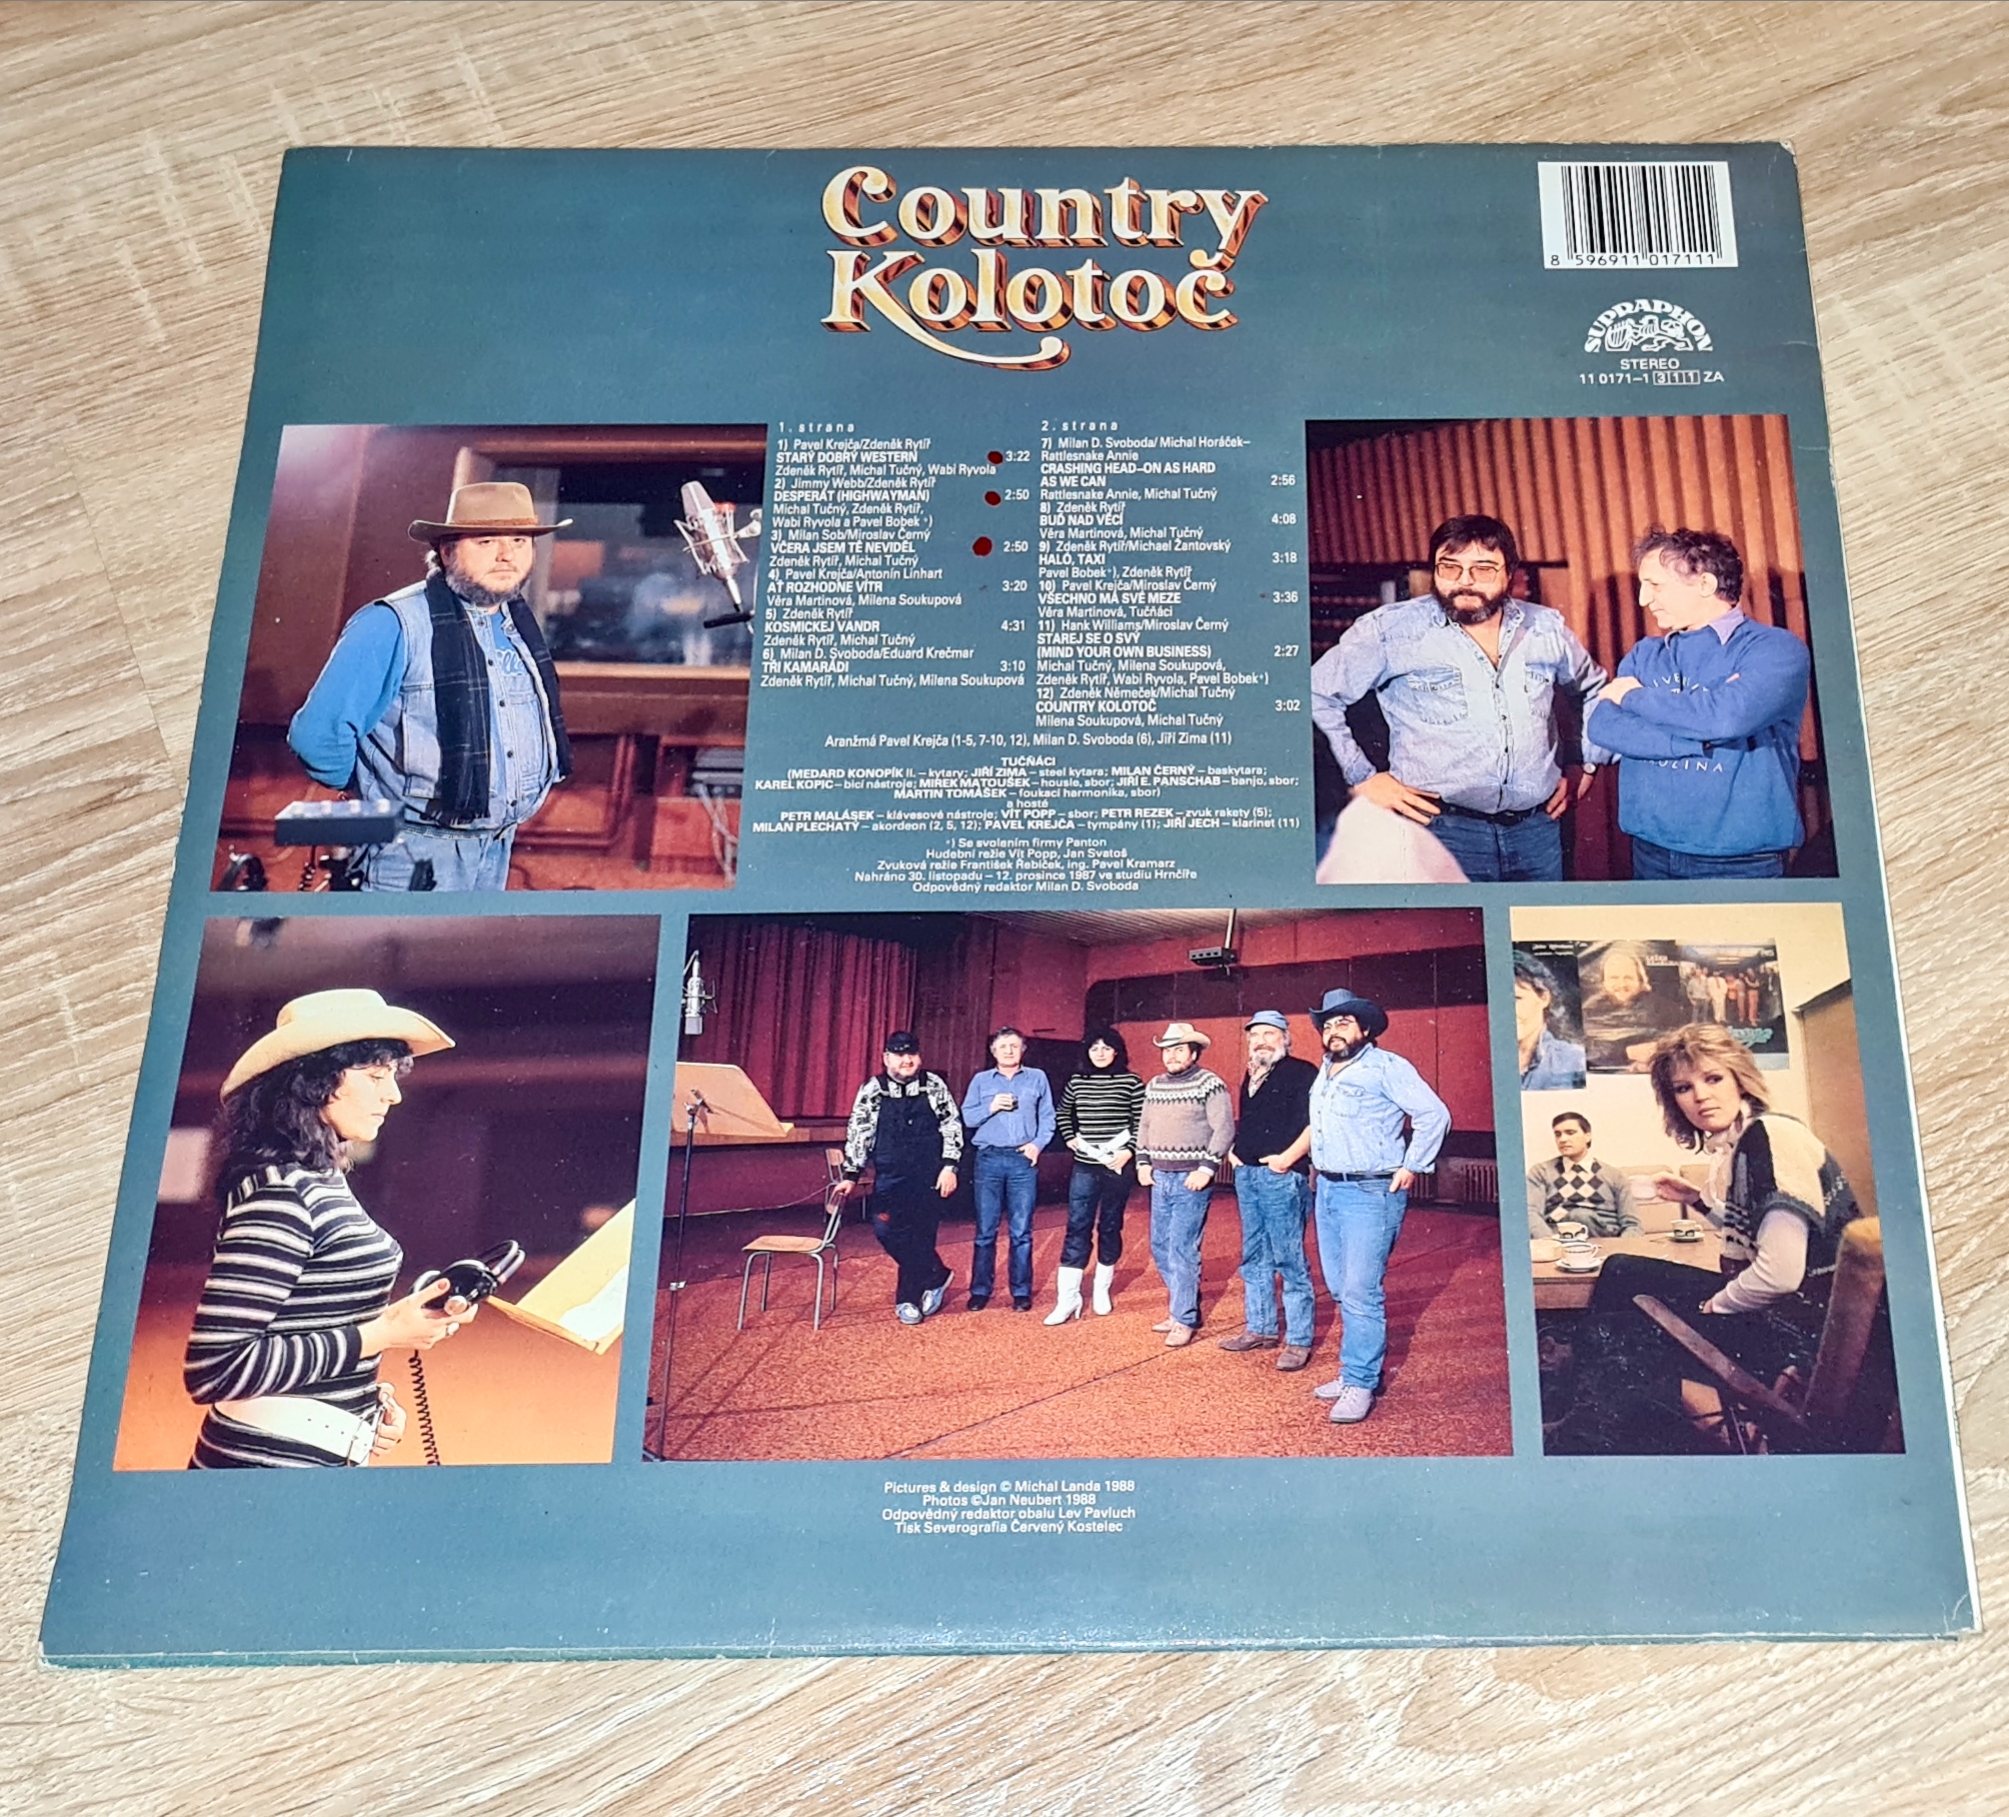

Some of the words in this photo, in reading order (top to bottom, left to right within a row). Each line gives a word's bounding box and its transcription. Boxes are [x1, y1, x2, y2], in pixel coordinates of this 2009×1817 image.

[822, 165, 1268, 270] Country
[1550, 255, 1560, 266] 8
[1575, 254, 1640, 266] 596911
[1649, 254, 1715, 265] 017111
[820, 249, 1239, 371] Kolotoč
[1584, 299, 1713, 353] SUPRAPHON
[1620, 358, 1680, 370] STEREO
[1703, 371, 1724, 382] ZA
[779, 422, 792, 433] 1.
[798, 422, 856, 433] strana
[1041, 421, 1056, 432] 2.
[1062, 421, 1119, 432] strana
[778, 439, 788, 452] 1)
[793, 440, 823, 451] Pavel
[860, 452, 919, 463] WESTERN
[1006, 452, 1031, 463] 3:22
[1041, 451, 1104, 462] Rattlesnake
[1106, 450, 1139, 462] Annie
[849, 465, 887, 476] Michal
[928, 465, 956, 476] Wabi
[958, 464, 997, 478] Ryvola
[1040, 463, 1102, 475] CRASHING
[1163, 463, 1180, 474] AS
[1182, 462, 1217, 474] HARD
[1040, 476, 1057, 487] AS
[1059, 476, 1078, 487] WE
[1080, 476, 1107, 487] CAN
[1271, 476, 1296, 487] 2:56
[837, 490, 930, 504] (HIGHWAYMAN)
[1005, 490, 1030, 501] 2:50
[1067, 515, 1094, 526] NAD
[1272, 515, 1297, 526] 4:08
[812, 543, 846, 554] JSEM
[1004, 542, 1029, 553] 2:50
[1078, 554, 1106, 565] TAXI
[1272, 553, 1298, 564] 3:18
[786, 582, 853, 593] ROZHODNE
[1002, 581, 1028, 592] 3:20
[1148, 593, 1182, 604] MEZE
[1273, 592, 1299, 604] 3:36
[765, 622, 834, 633] KOSMICKEJ
[837, 622, 881, 633] VANDR
[1001, 621, 1026, 632] 4:31
[1038, 634, 1083, 645] STAREJ
[1085, 633, 1101, 644] SE
[1103, 633, 1113, 644] O
[763, 649, 774, 662] 6)
[780, 649, 812, 660] Milan
[814, 649, 826, 660] D.
[1037, 646, 1074, 660] (MIND
[1076, 647, 1111, 658] YOUR
[1113, 647, 1144, 658] OWN
[1146, 646, 1212, 659] BUSINESS)
[1274, 646, 1300, 657] 2:27
[1000, 662, 1026, 673] 3:10
[1036, 702, 1095, 713] COUNTRY
[1275, 701, 1301, 712] 3:02
[879, 736, 910, 748] Pavel
[951, 735, 976, 749] (1-5,
[980, 735, 1006, 749] 7-10,
[1010, 735, 1030, 749] 12),
[1033, 735, 1065, 747] Milan
[1068, 735, 1080, 746] D.
[1082, 734, 1134, 746] Svoboda
[1136, 734, 1155, 748] (6),
[1178, 734, 1207, 746] Zima
[1210, 733, 1232, 747] (11)
[1007, 801, 1014, 809] a
[958, 838, 974, 848] Se
[1032, 838, 1063, 850] firmy
[1066, 838, 1107, 848] Panton
[1027, 849, 1061, 861] Popp,
[1063, 849, 1085, 859] Jan
[1067, 860, 1089, 872] ing.
[1092, 859, 1124, 870] Pavel
[1126, 859, 1176, 869] Kramarz
[908, 871, 926, 882] 30.
[928, 871, 982, 884] listopadu
[996, 871, 1012, 881] 12.
[1015, 870, 1066, 883] prosince
[1069, 870, 1096, 880] 1987
[1098, 872, 1113, 880] ve
[1115, 870, 1152, 880] studiu
[984, 882, 1033, 892] redaktor
[1036, 882, 1068, 892] Milan
[1071, 882, 1083, 892] D.
[1087, 881, 1139, 892] Svoboda
[884, 1482, 936, 1494] Pictures
[953, 1482, 996, 1496] design
[1014, 1481, 1058, 1493] Michal
[1061, 1481, 1101, 1493] Landa
[1105, 1481, 1136, 1493] 1988
[923, 1495, 968, 1507] Photos
[1009, 1495, 1062, 1506] Neubert
[1066, 1494, 1096, 1506] 1988
[961, 1508, 1016, 1520] redaktor
[1018, 1508, 1055, 1520] obalu
[1058, 1508, 1082, 1520] Lev
[1084, 1507, 1136, 1519] Pavluch
[895, 1522, 921, 1534] Tisk
[924, 1522, 1007, 1536] Severografia
[1067, 1521, 1124, 1533] Kostelec
